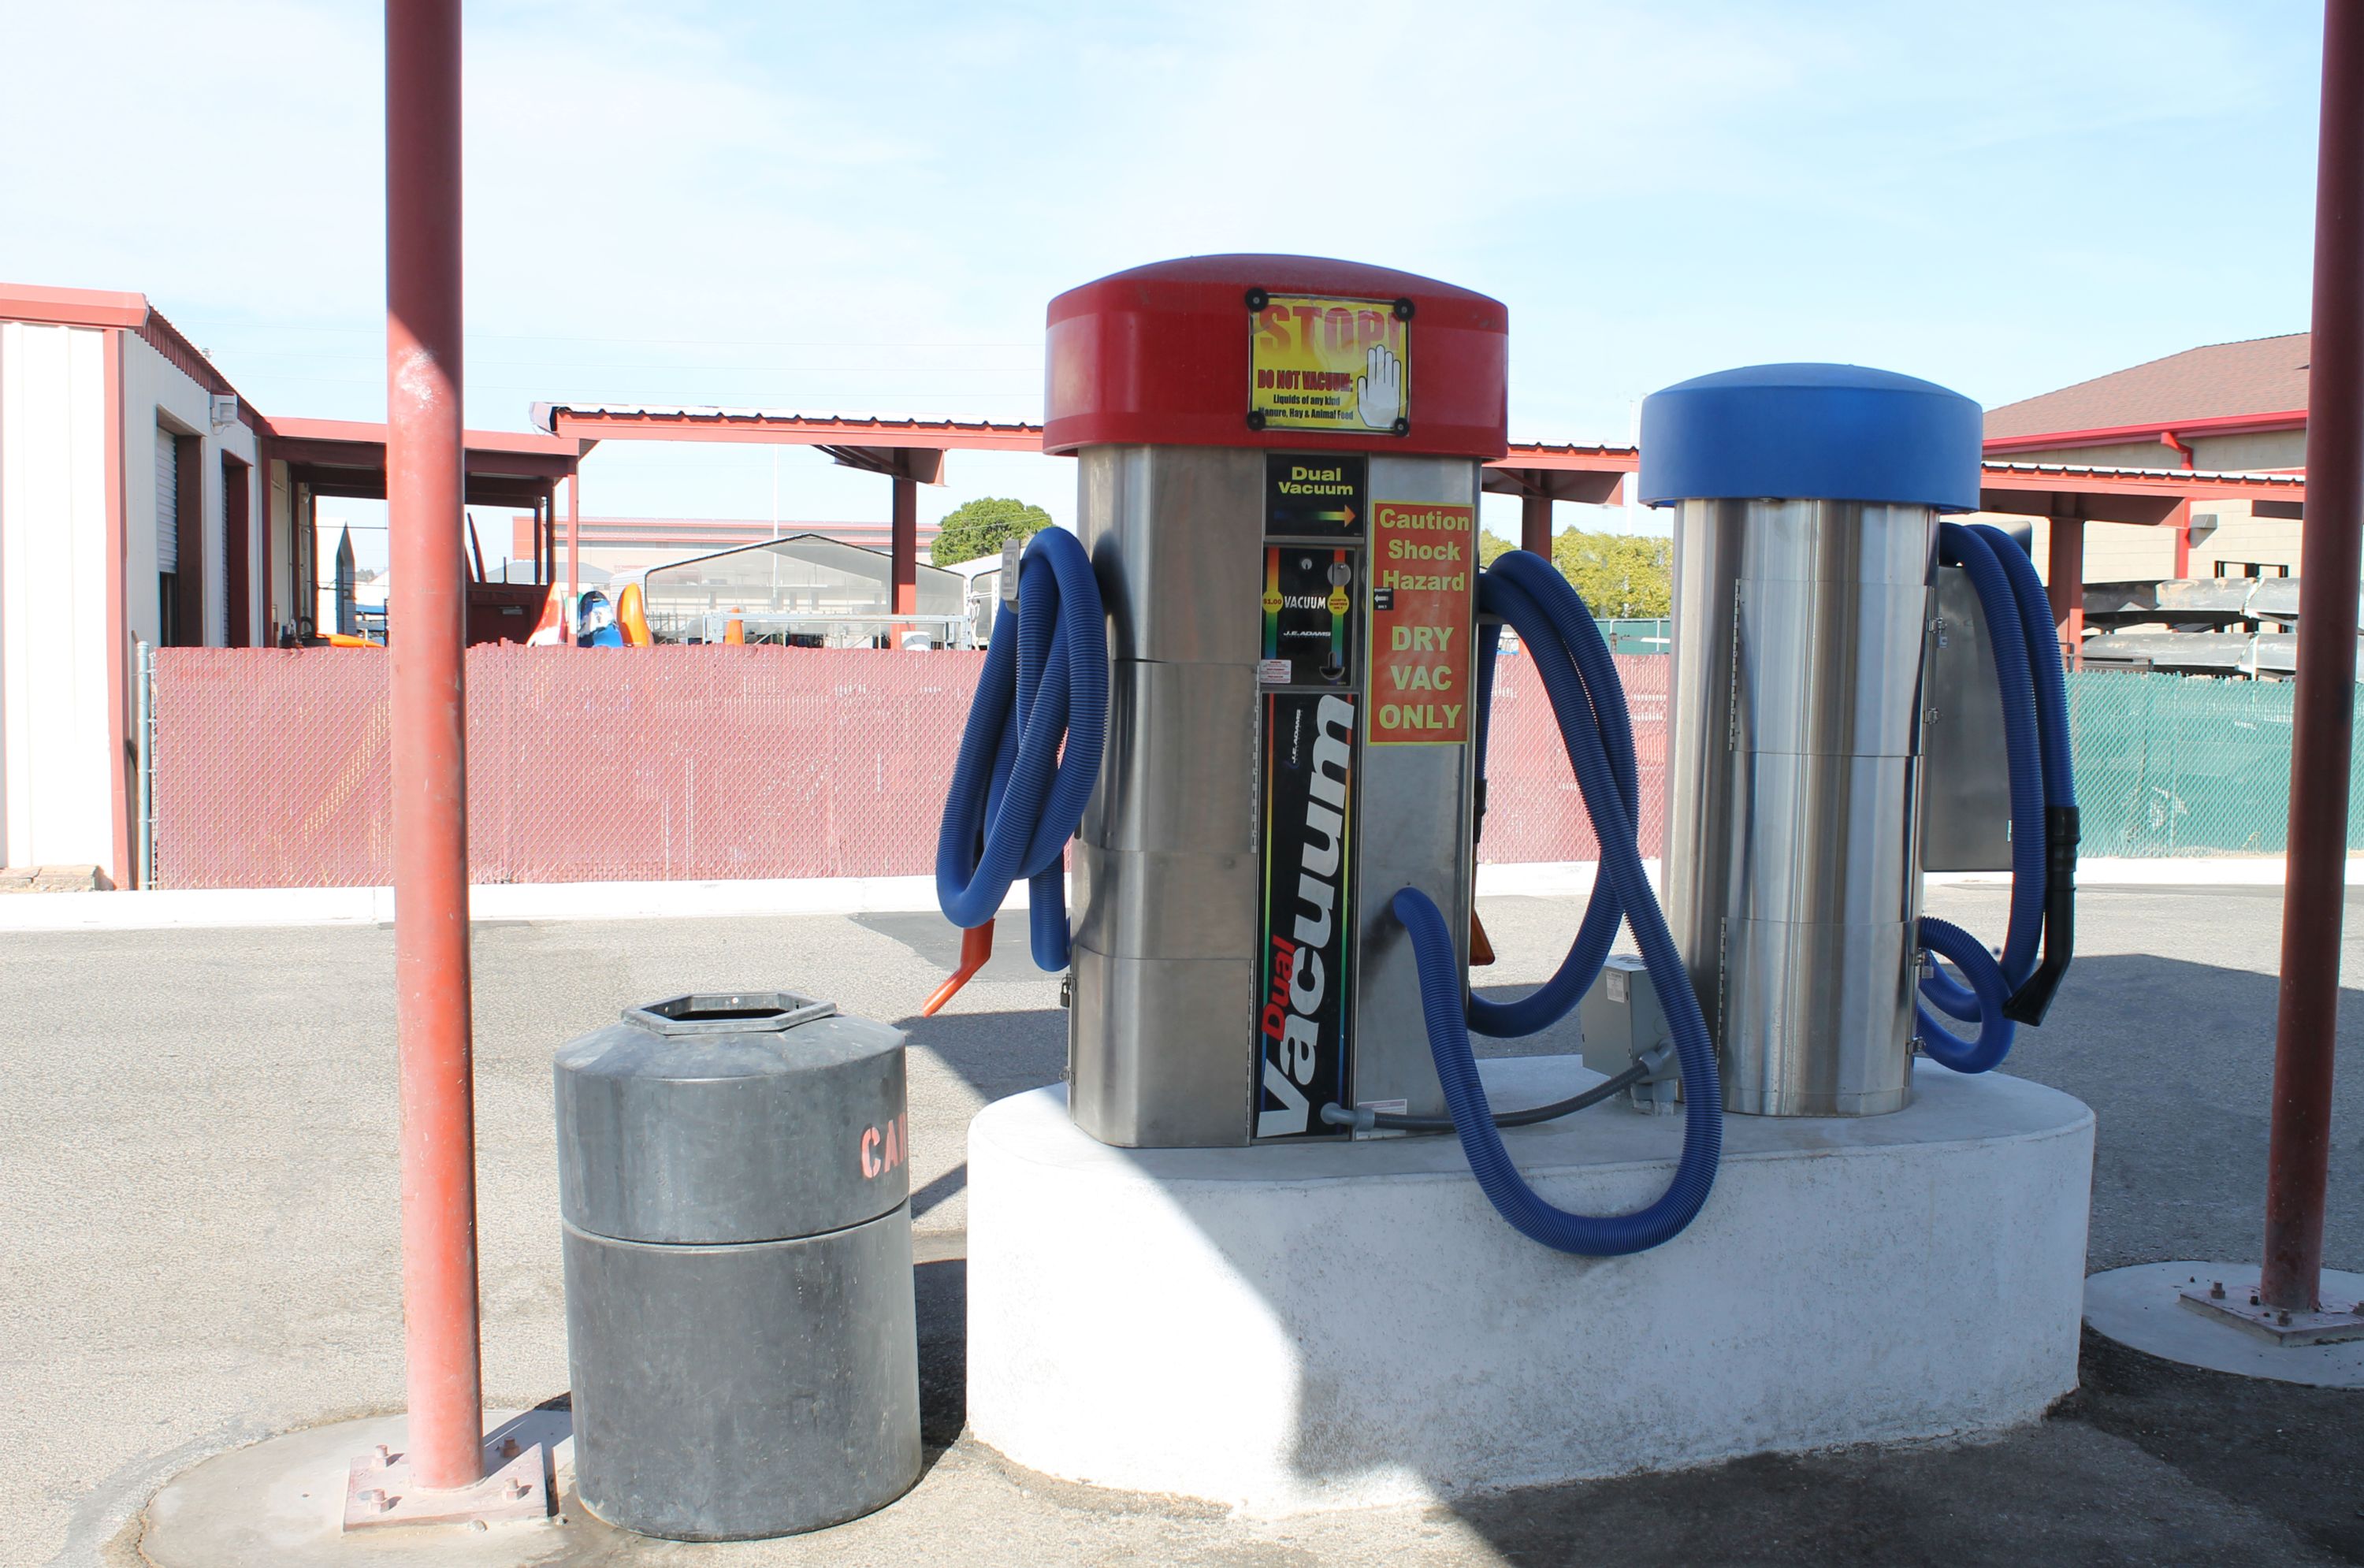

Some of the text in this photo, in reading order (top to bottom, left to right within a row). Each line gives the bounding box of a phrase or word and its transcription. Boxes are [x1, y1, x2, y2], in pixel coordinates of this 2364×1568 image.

[1258, 370, 1353, 392] DO NOT VACUUM:
[1273, 394, 1340, 407] Liquids of any kind
[1290, 409, 1303, 418] Hay
[1311, 409, 1336, 419] Animal
[1337, 410, 1353, 420] Feed
[1292, 466, 1341, 481] Dual
[1278, 481, 1353, 495] Vacuum
[1380, 508, 1469, 530] Caution
[1388, 539, 1460, 561] Shock
[1383, 570, 1464, 591] Hazard
[1284, 596, 1326, 609] VACUUM
[1392, 626, 1454, 652] DRY
[1390, 666, 1452, 690] VAC
[1379, 704, 1462, 729] ONLY
[1257, 693, 1355, 1139] Vacuum
[1262, 934, 1297, 1042] Dual
